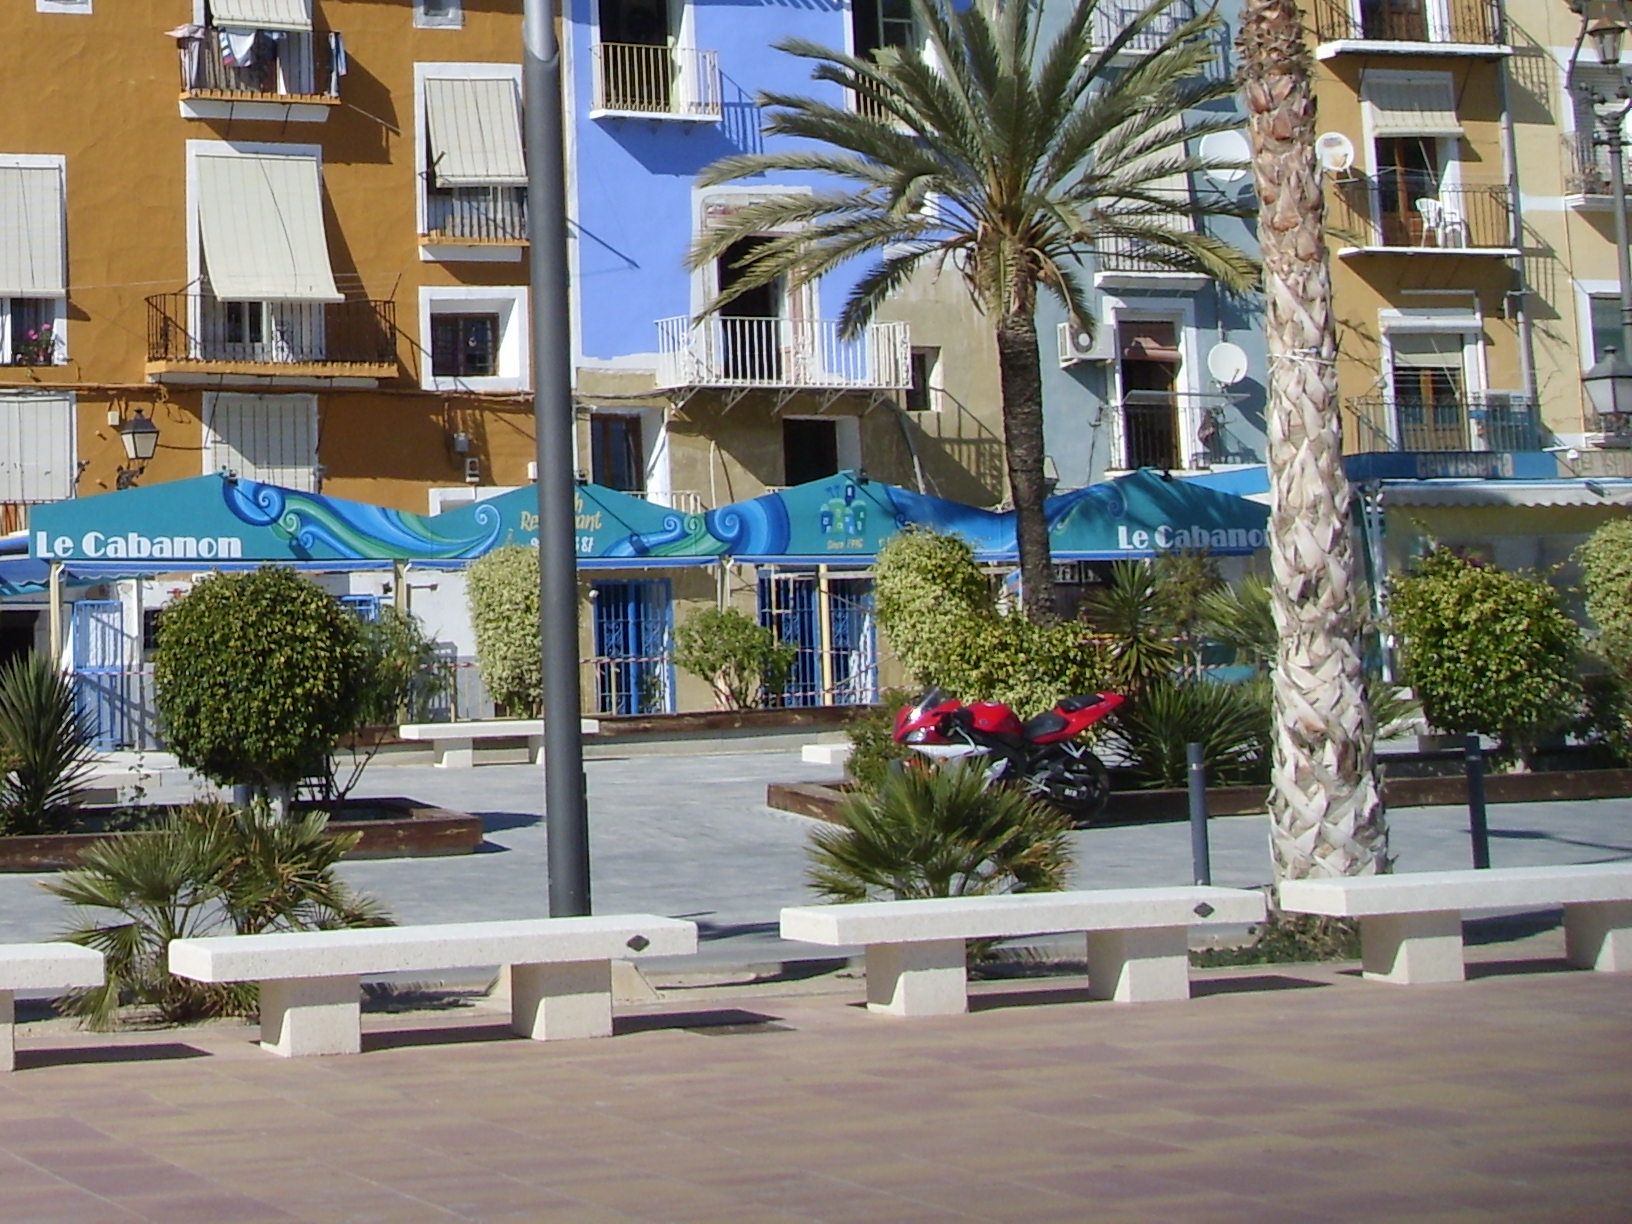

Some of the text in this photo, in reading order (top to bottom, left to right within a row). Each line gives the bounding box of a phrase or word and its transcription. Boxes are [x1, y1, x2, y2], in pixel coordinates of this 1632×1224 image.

[36, 531, 242, 558] Le Cabanon
[1118, 525, 1269, 549] Le Cabano
